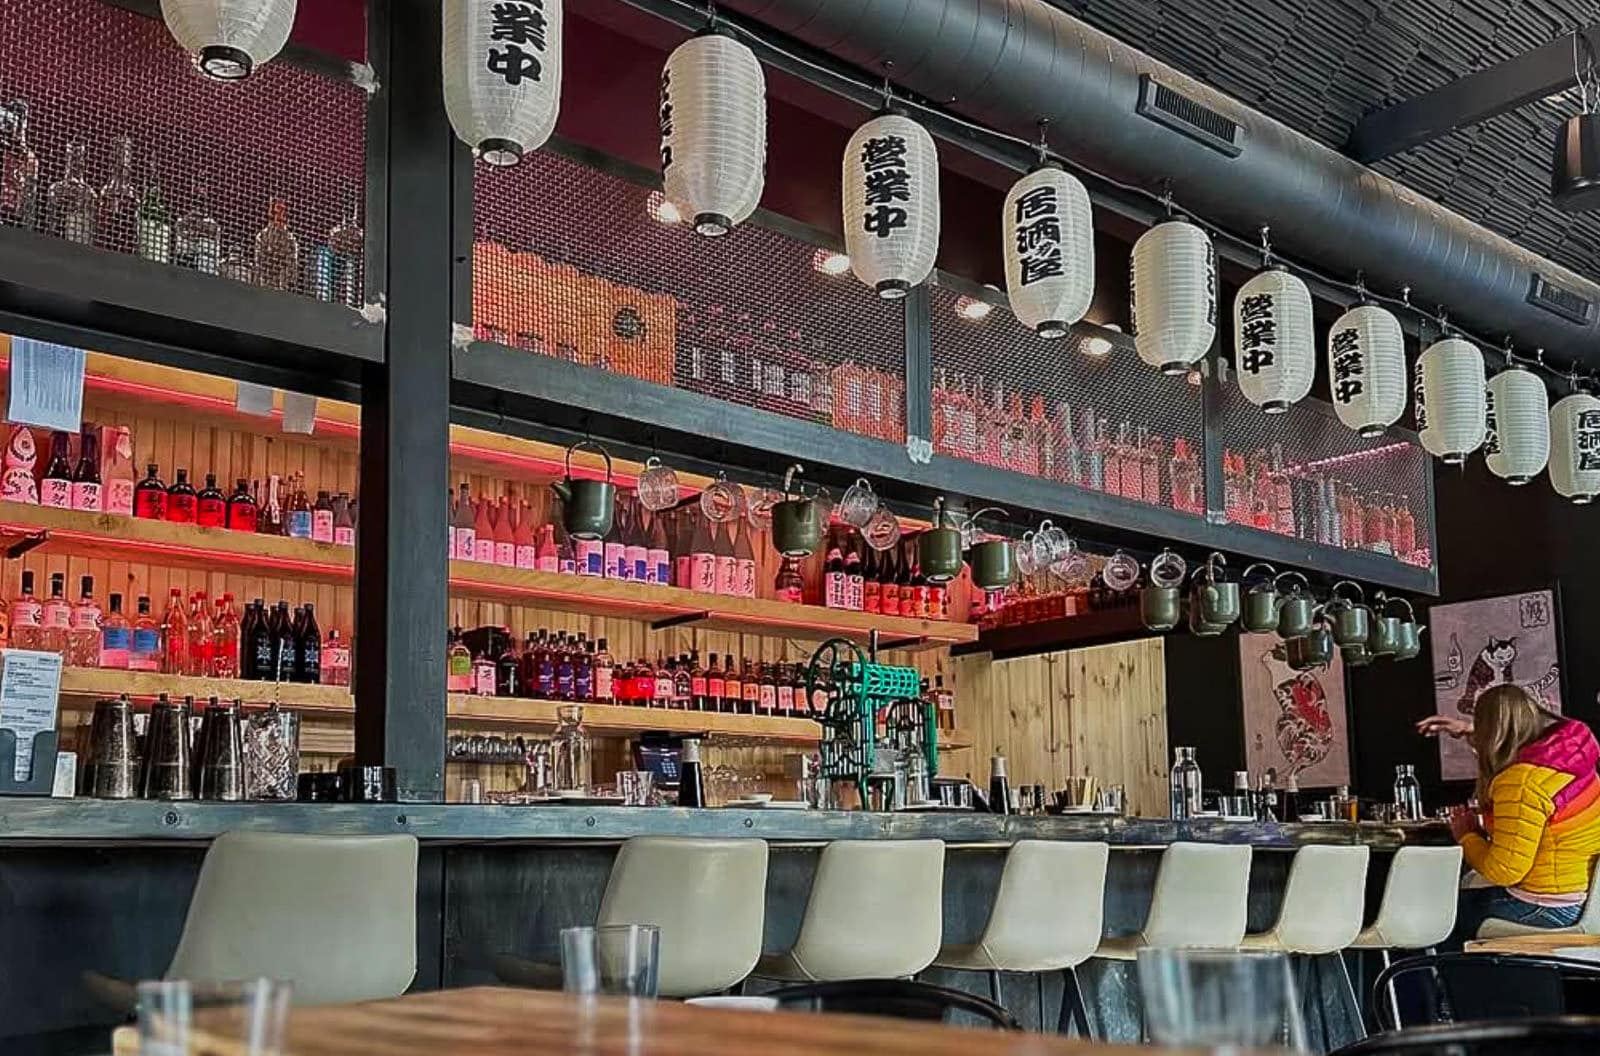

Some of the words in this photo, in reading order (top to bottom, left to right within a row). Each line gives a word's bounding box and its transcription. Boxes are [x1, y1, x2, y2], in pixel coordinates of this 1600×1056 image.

[487, 0, 547, 86] 業中
[1015, 186, 1064, 286] 居酒屋
